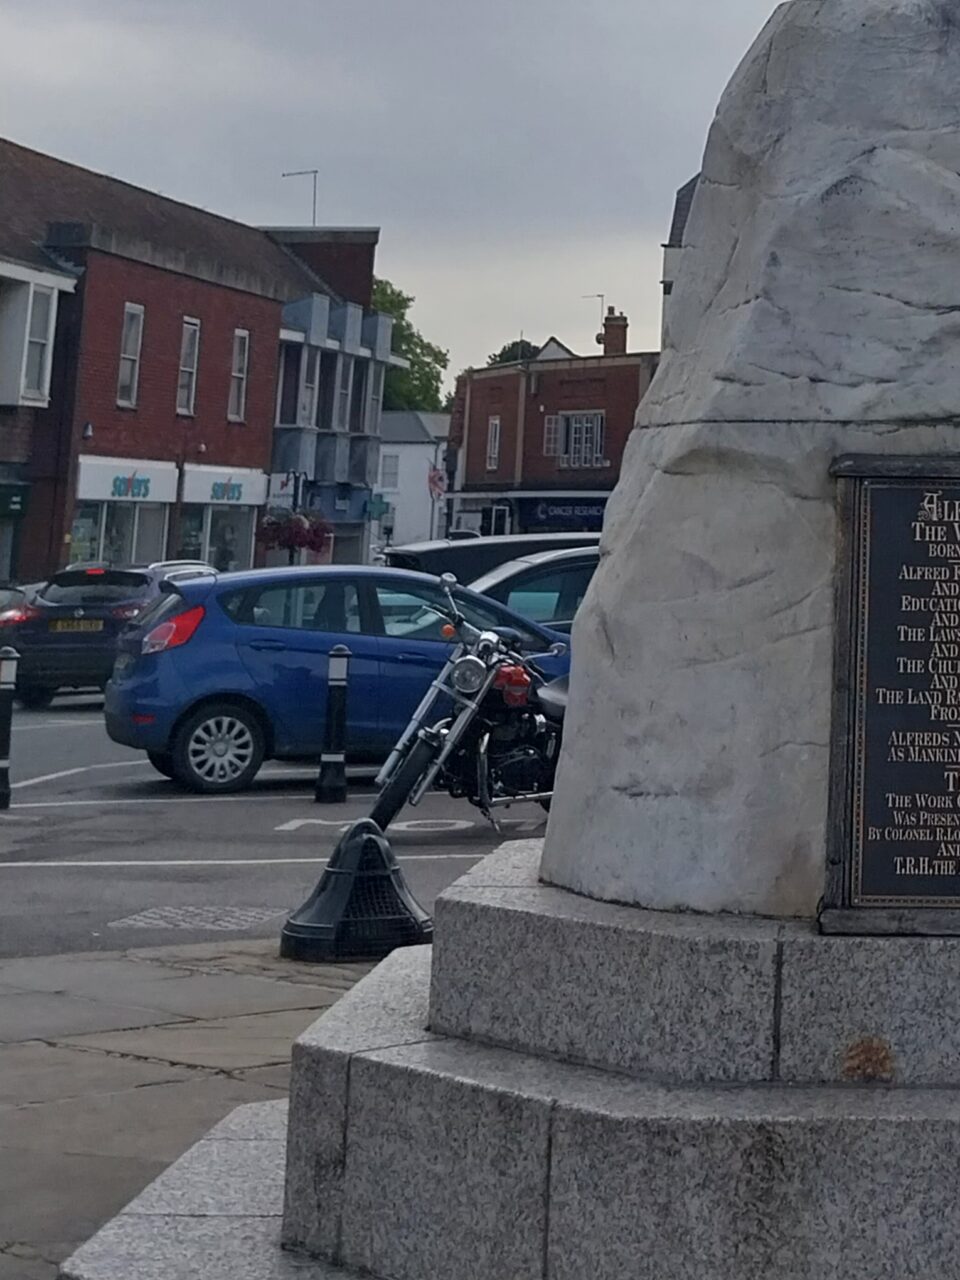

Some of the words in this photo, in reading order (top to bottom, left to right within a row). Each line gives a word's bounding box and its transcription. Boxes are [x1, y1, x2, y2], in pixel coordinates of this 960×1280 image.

[911, 522, 947, 541] THE
[899, 564, 950, 580] ALFRED
[931, 580, 960, 596] AND
[931, 611, 959, 627] AND
[897, 625, 926, 642] THE
[931, 642, 959, 657] AND
[896, 657, 925, 673] THE
[930, 674, 958, 689] AND
[876, 688, 904, 704] THE
[907, 688, 942, 705] LAND
[888, 730, 950, 746] ALFREDS
[888, 746, 905, 762] AS
[885, 793, 912, 808] THE
[916, 793, 954, 809] WORK
[893, 811, 917, 826] WAS
[868, 827, 882, 841] BY
[885, 827, 933, 841] COLONEL
